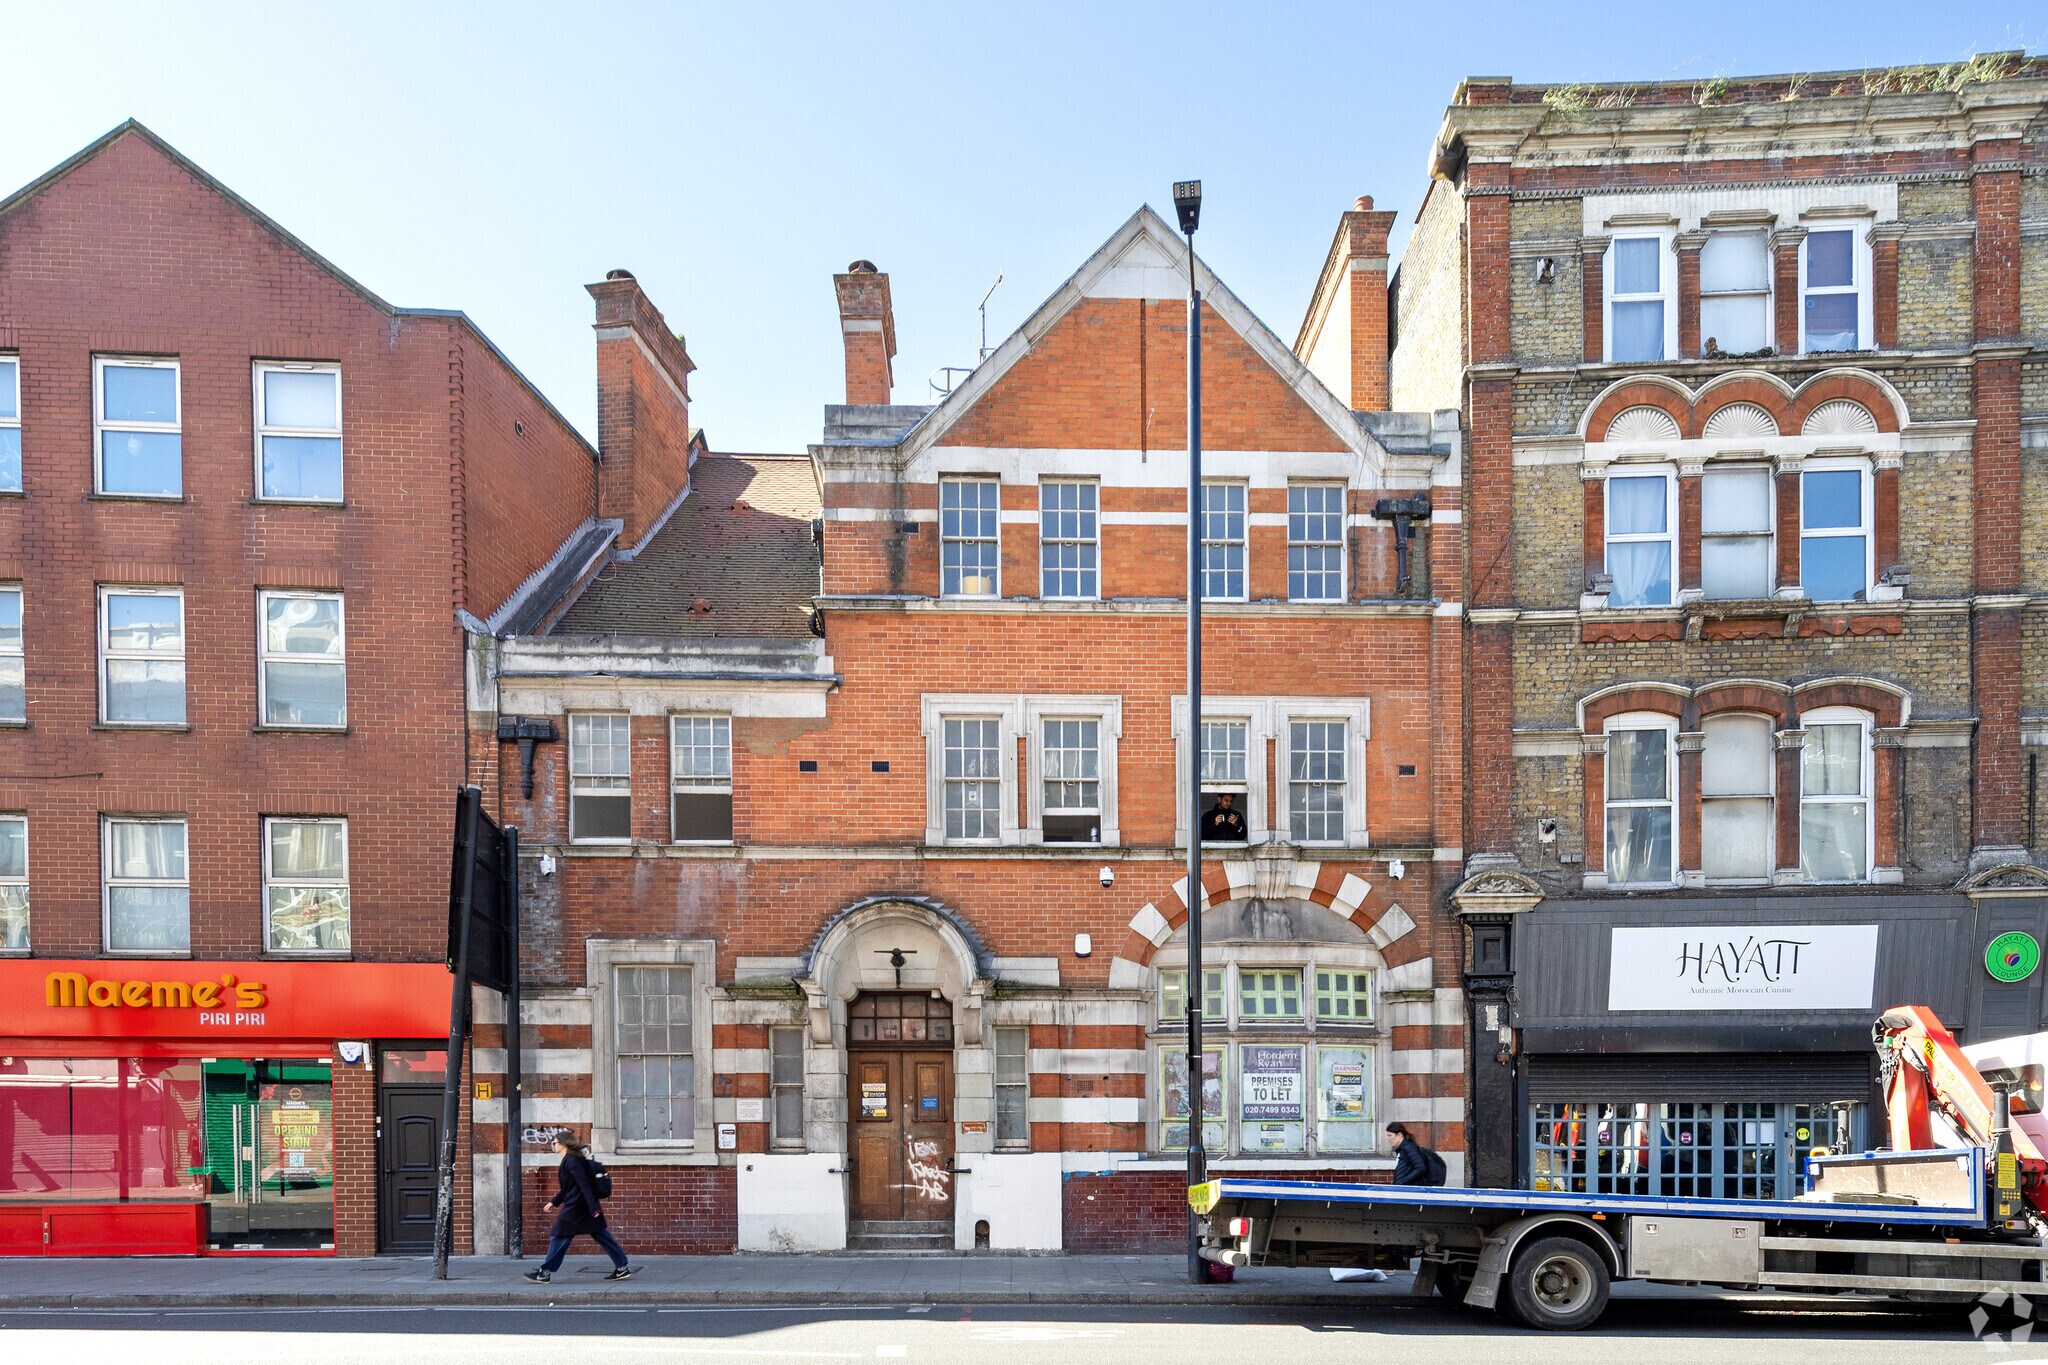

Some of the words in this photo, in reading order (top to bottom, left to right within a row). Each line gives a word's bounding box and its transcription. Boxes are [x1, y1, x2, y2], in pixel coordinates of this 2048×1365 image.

[1996, 935, 2030, 947] HAYATT
[1675, 935, 1812, 984] HAYATT
[1996, 966, 2030, 978] LOUNGE
[45, 971, 266, 1008] Maeme's
[1688, 986, 1725, 994] Authentic
[1726, 986, 1764, 994] Moroccan
[1765, 986, 1794, 994] Cuisine
[200, 1012, 230, 1026] PIRI
[235, 1012, 265, 1026] PIRI
[1257, 1050, 1297, 1059] Hordern
[1258, 1059, 1283, 1068] Ryan
[1251, 1076, 1293, 1086] PREMISES
[477, 1084, 489, 1098] H
[1253, 1088, 1268, 1101] TO
[1271, 1088, 1292, 1101] LET
[1280, 1106, 1300, 1114] 0343
[274, 1125, 318, 1136] OPENING
[283, 1137, 310, 1148] SOON
